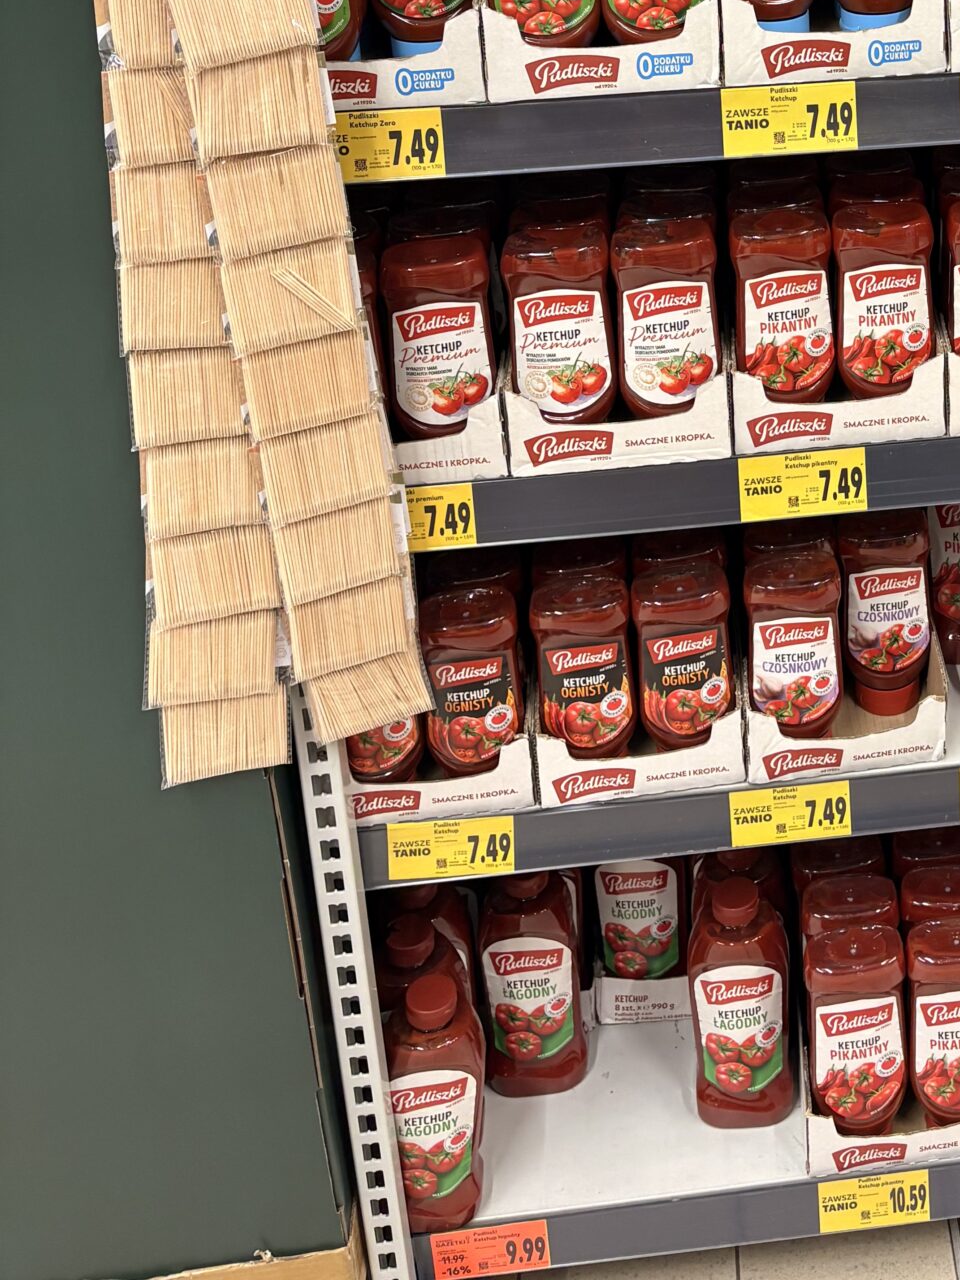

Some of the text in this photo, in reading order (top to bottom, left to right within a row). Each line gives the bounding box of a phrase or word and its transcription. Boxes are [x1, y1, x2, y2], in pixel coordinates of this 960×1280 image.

[653, 55, 691, 65] DODATKU
[535, 60, 614, 88] Pudliszki
[654, 64, 681, 74] CUKRU
[350, 121, 378, 130] Ketchup
[389, 128, 439, 166] 7.49
[856, 273, 917, 297] Pudliszki
[866, 302, 908, 315] KETCHUP
[858, 310, 916, 327] PIKANTNY
[520, 332, 599, 353] Premium
[536, 329, 581, 342] KETCHUP
[533, 435, 608, 460] Pudliszki
[819, 466, 863, 501] 7.49
[762, 658, 828, 673] CZOSNKOWY
[775, 651, 816, 663] KETCHUP
[662, 668, 709, 686] OGNISTY
[665, 661, 706, 676] KETCHUP
[468, 832, 511, 863] 7.49
[713, 1011, 769, 1030] ŁAGODNY
[718, 1006, 761, 1020] KETCHUP
[822, 1200, 858, 1212] TANIO
[889, 1183, 927, 1214] 10.59
[506, 1237, 545, 1264] 9.99
[442, 1266, 471, 1276] -16%
